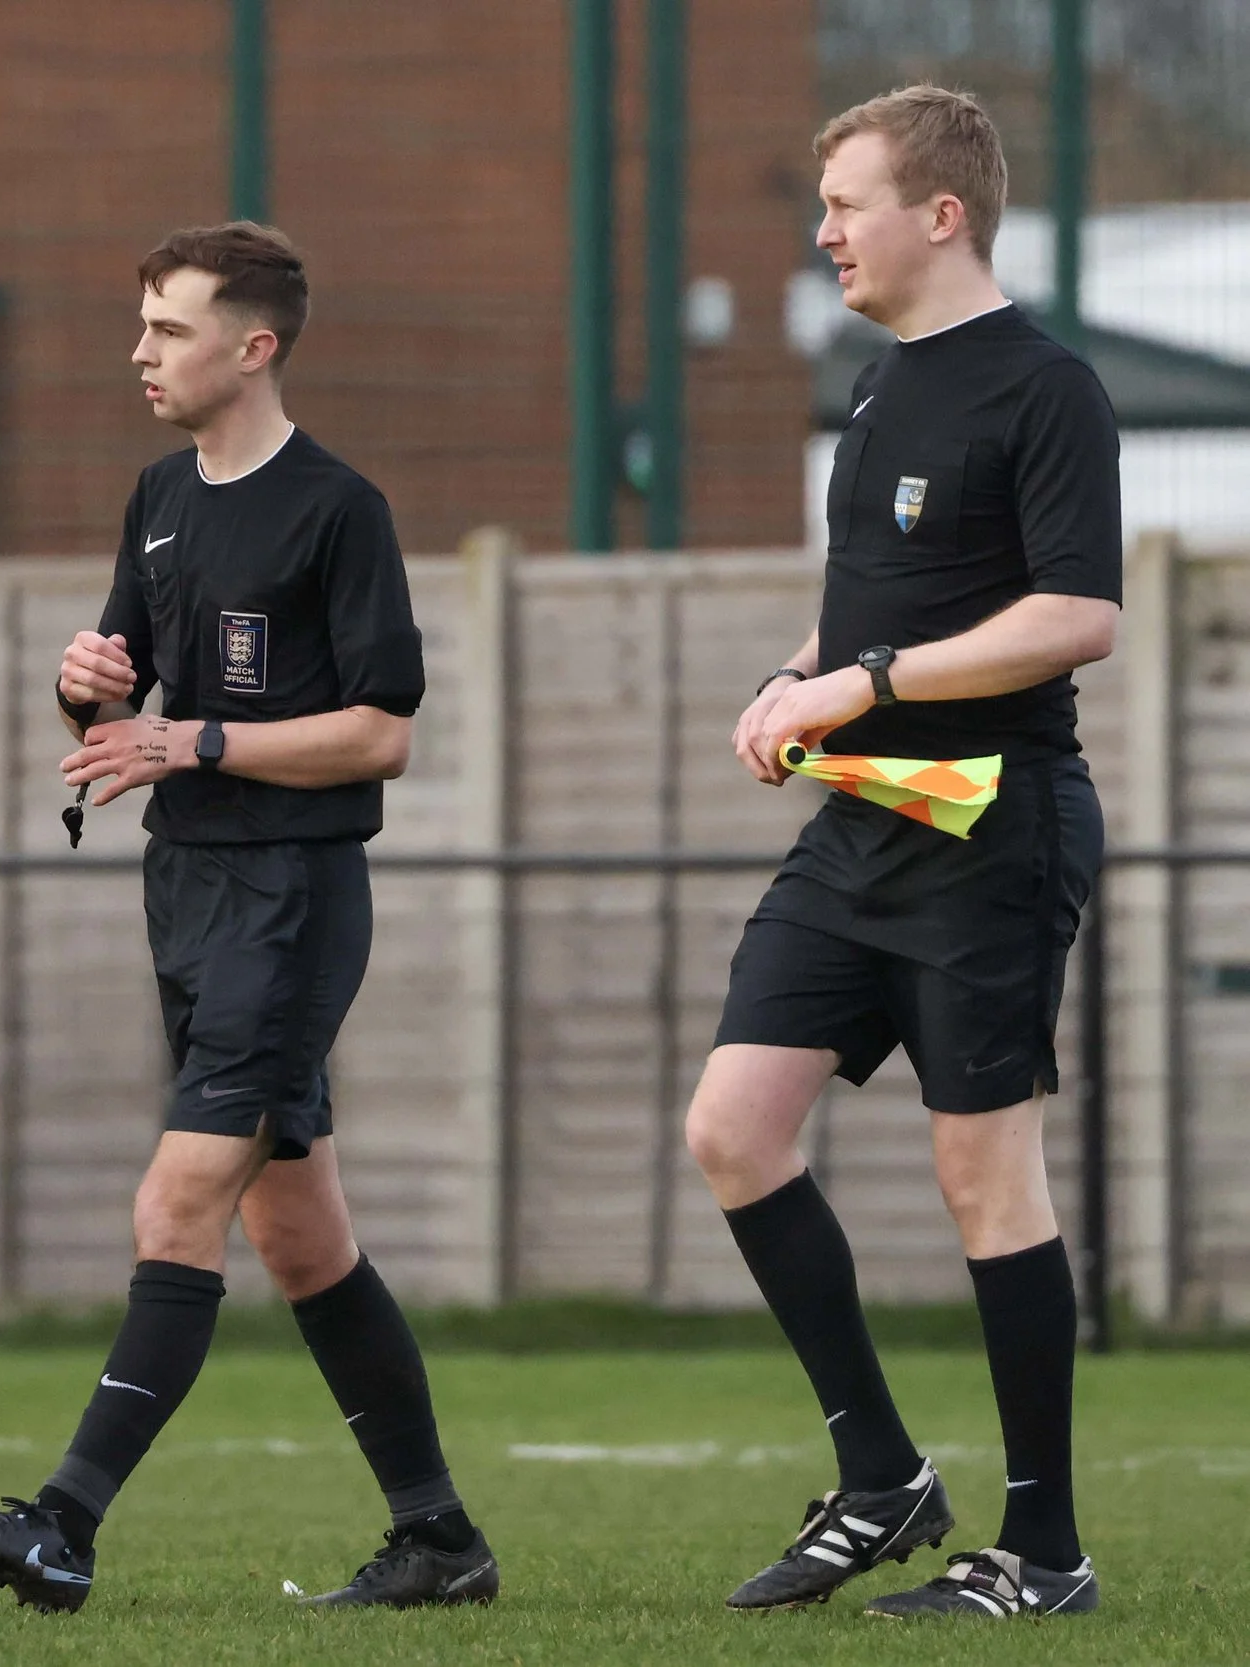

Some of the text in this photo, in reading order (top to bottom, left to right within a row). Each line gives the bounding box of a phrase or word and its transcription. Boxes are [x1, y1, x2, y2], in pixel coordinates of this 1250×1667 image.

[226, 665, 255, 675] MATCH
[224, 674, 259, 684] OFFICIAL
[970, 1571, 996, 1582] adidas
